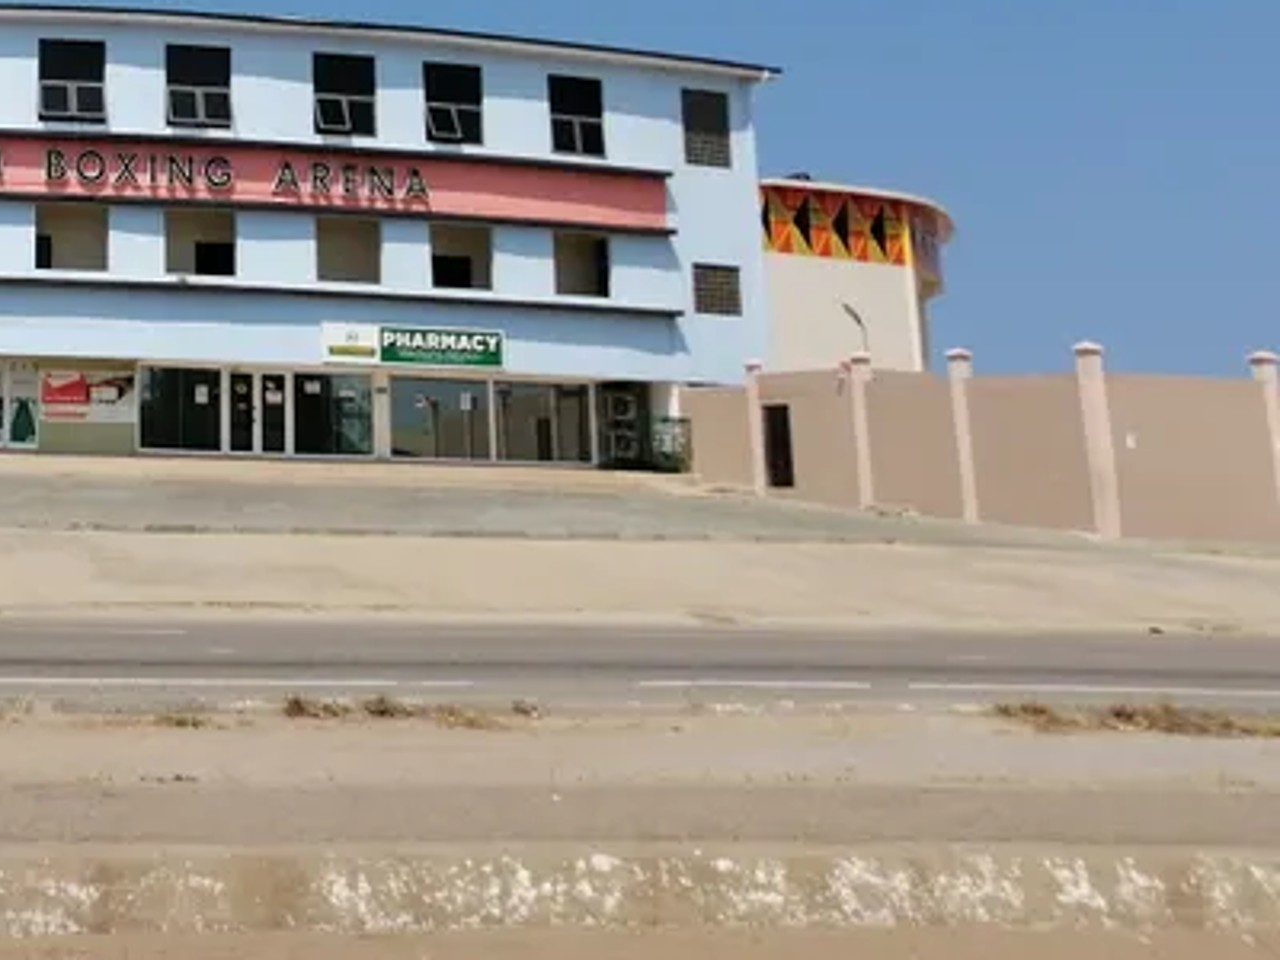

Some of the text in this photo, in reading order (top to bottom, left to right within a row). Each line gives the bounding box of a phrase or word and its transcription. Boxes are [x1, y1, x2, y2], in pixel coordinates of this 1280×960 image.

[46, 149, 232, 187] BOXING
[274, 161, 431, 200] ARENA
[382, 331, 499, 353] PHARMACY
